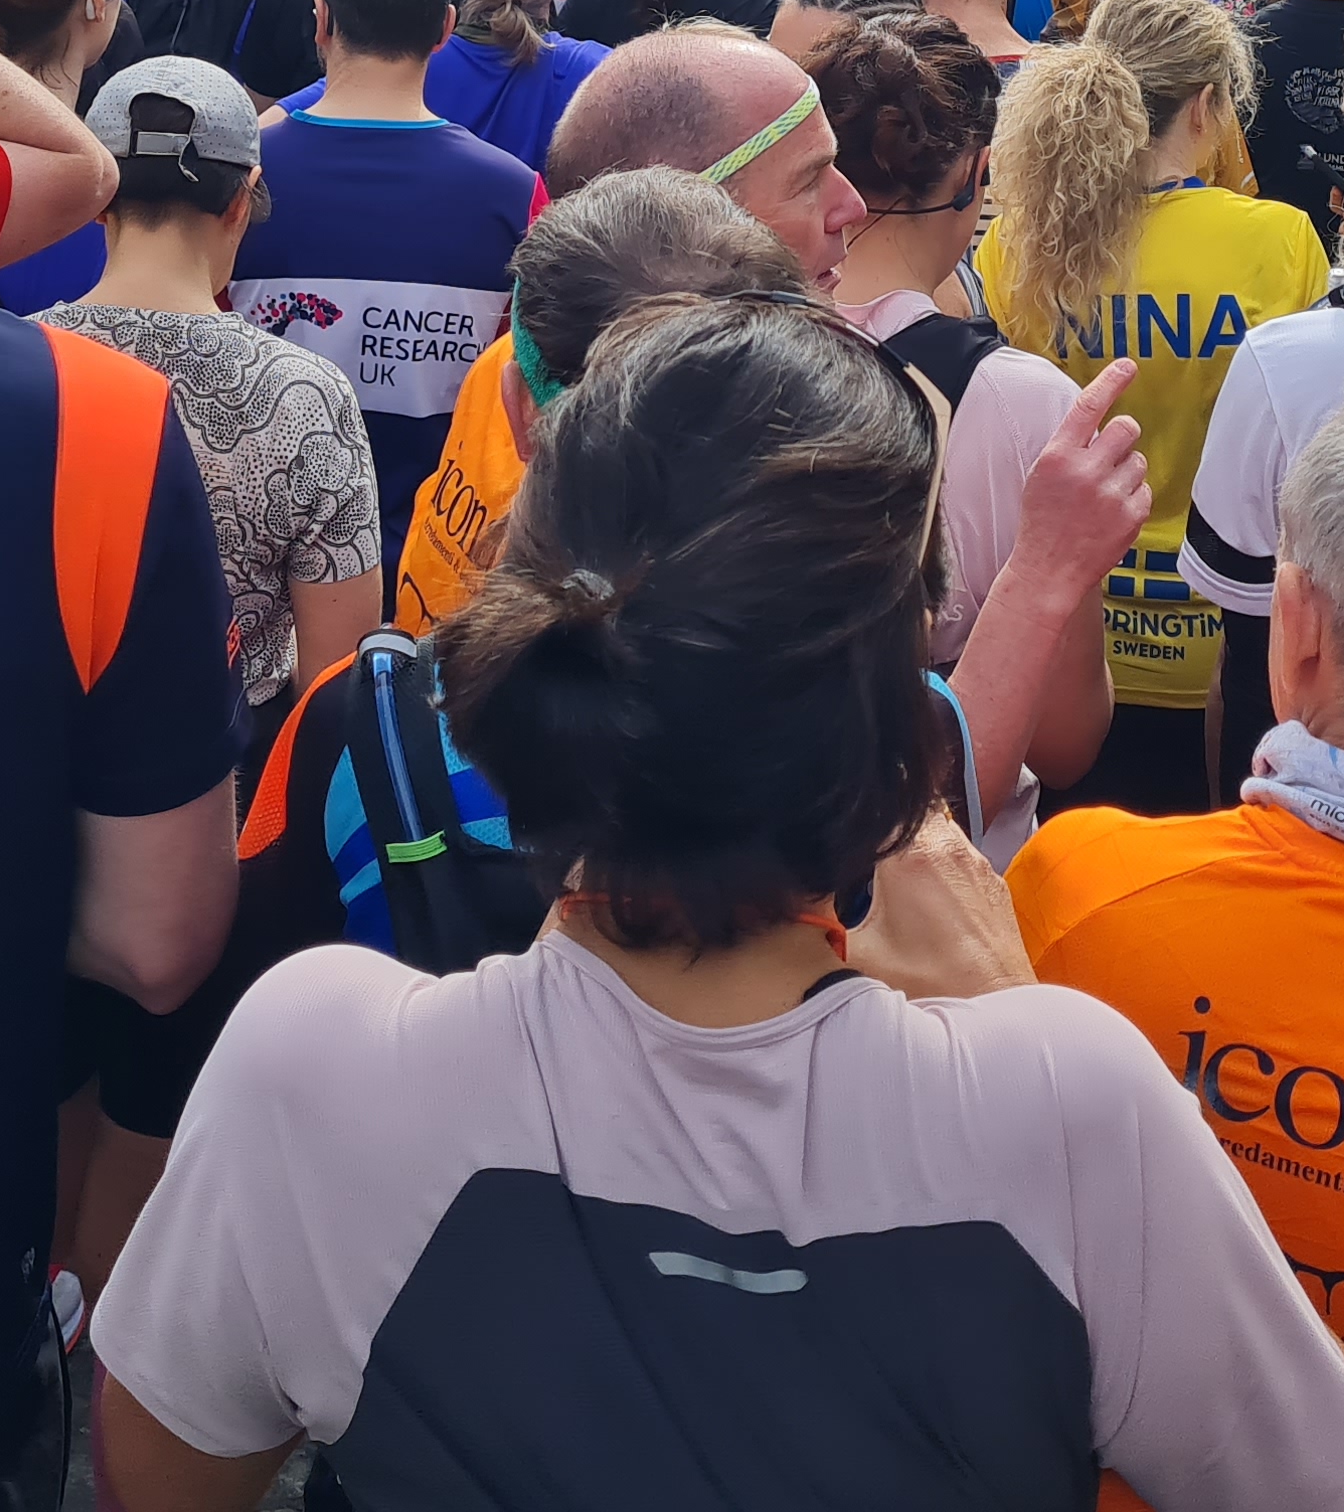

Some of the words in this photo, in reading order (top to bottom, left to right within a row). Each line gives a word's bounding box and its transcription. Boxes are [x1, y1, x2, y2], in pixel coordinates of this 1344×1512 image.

[362, 306, 474, 337] CANCER
[1056, 293, 1249, 359] NINA
[359, 362, 396, 387] UK
[430, 440, 498, 558] icon
[1112, 640, 1185, 661] SWEDEN
